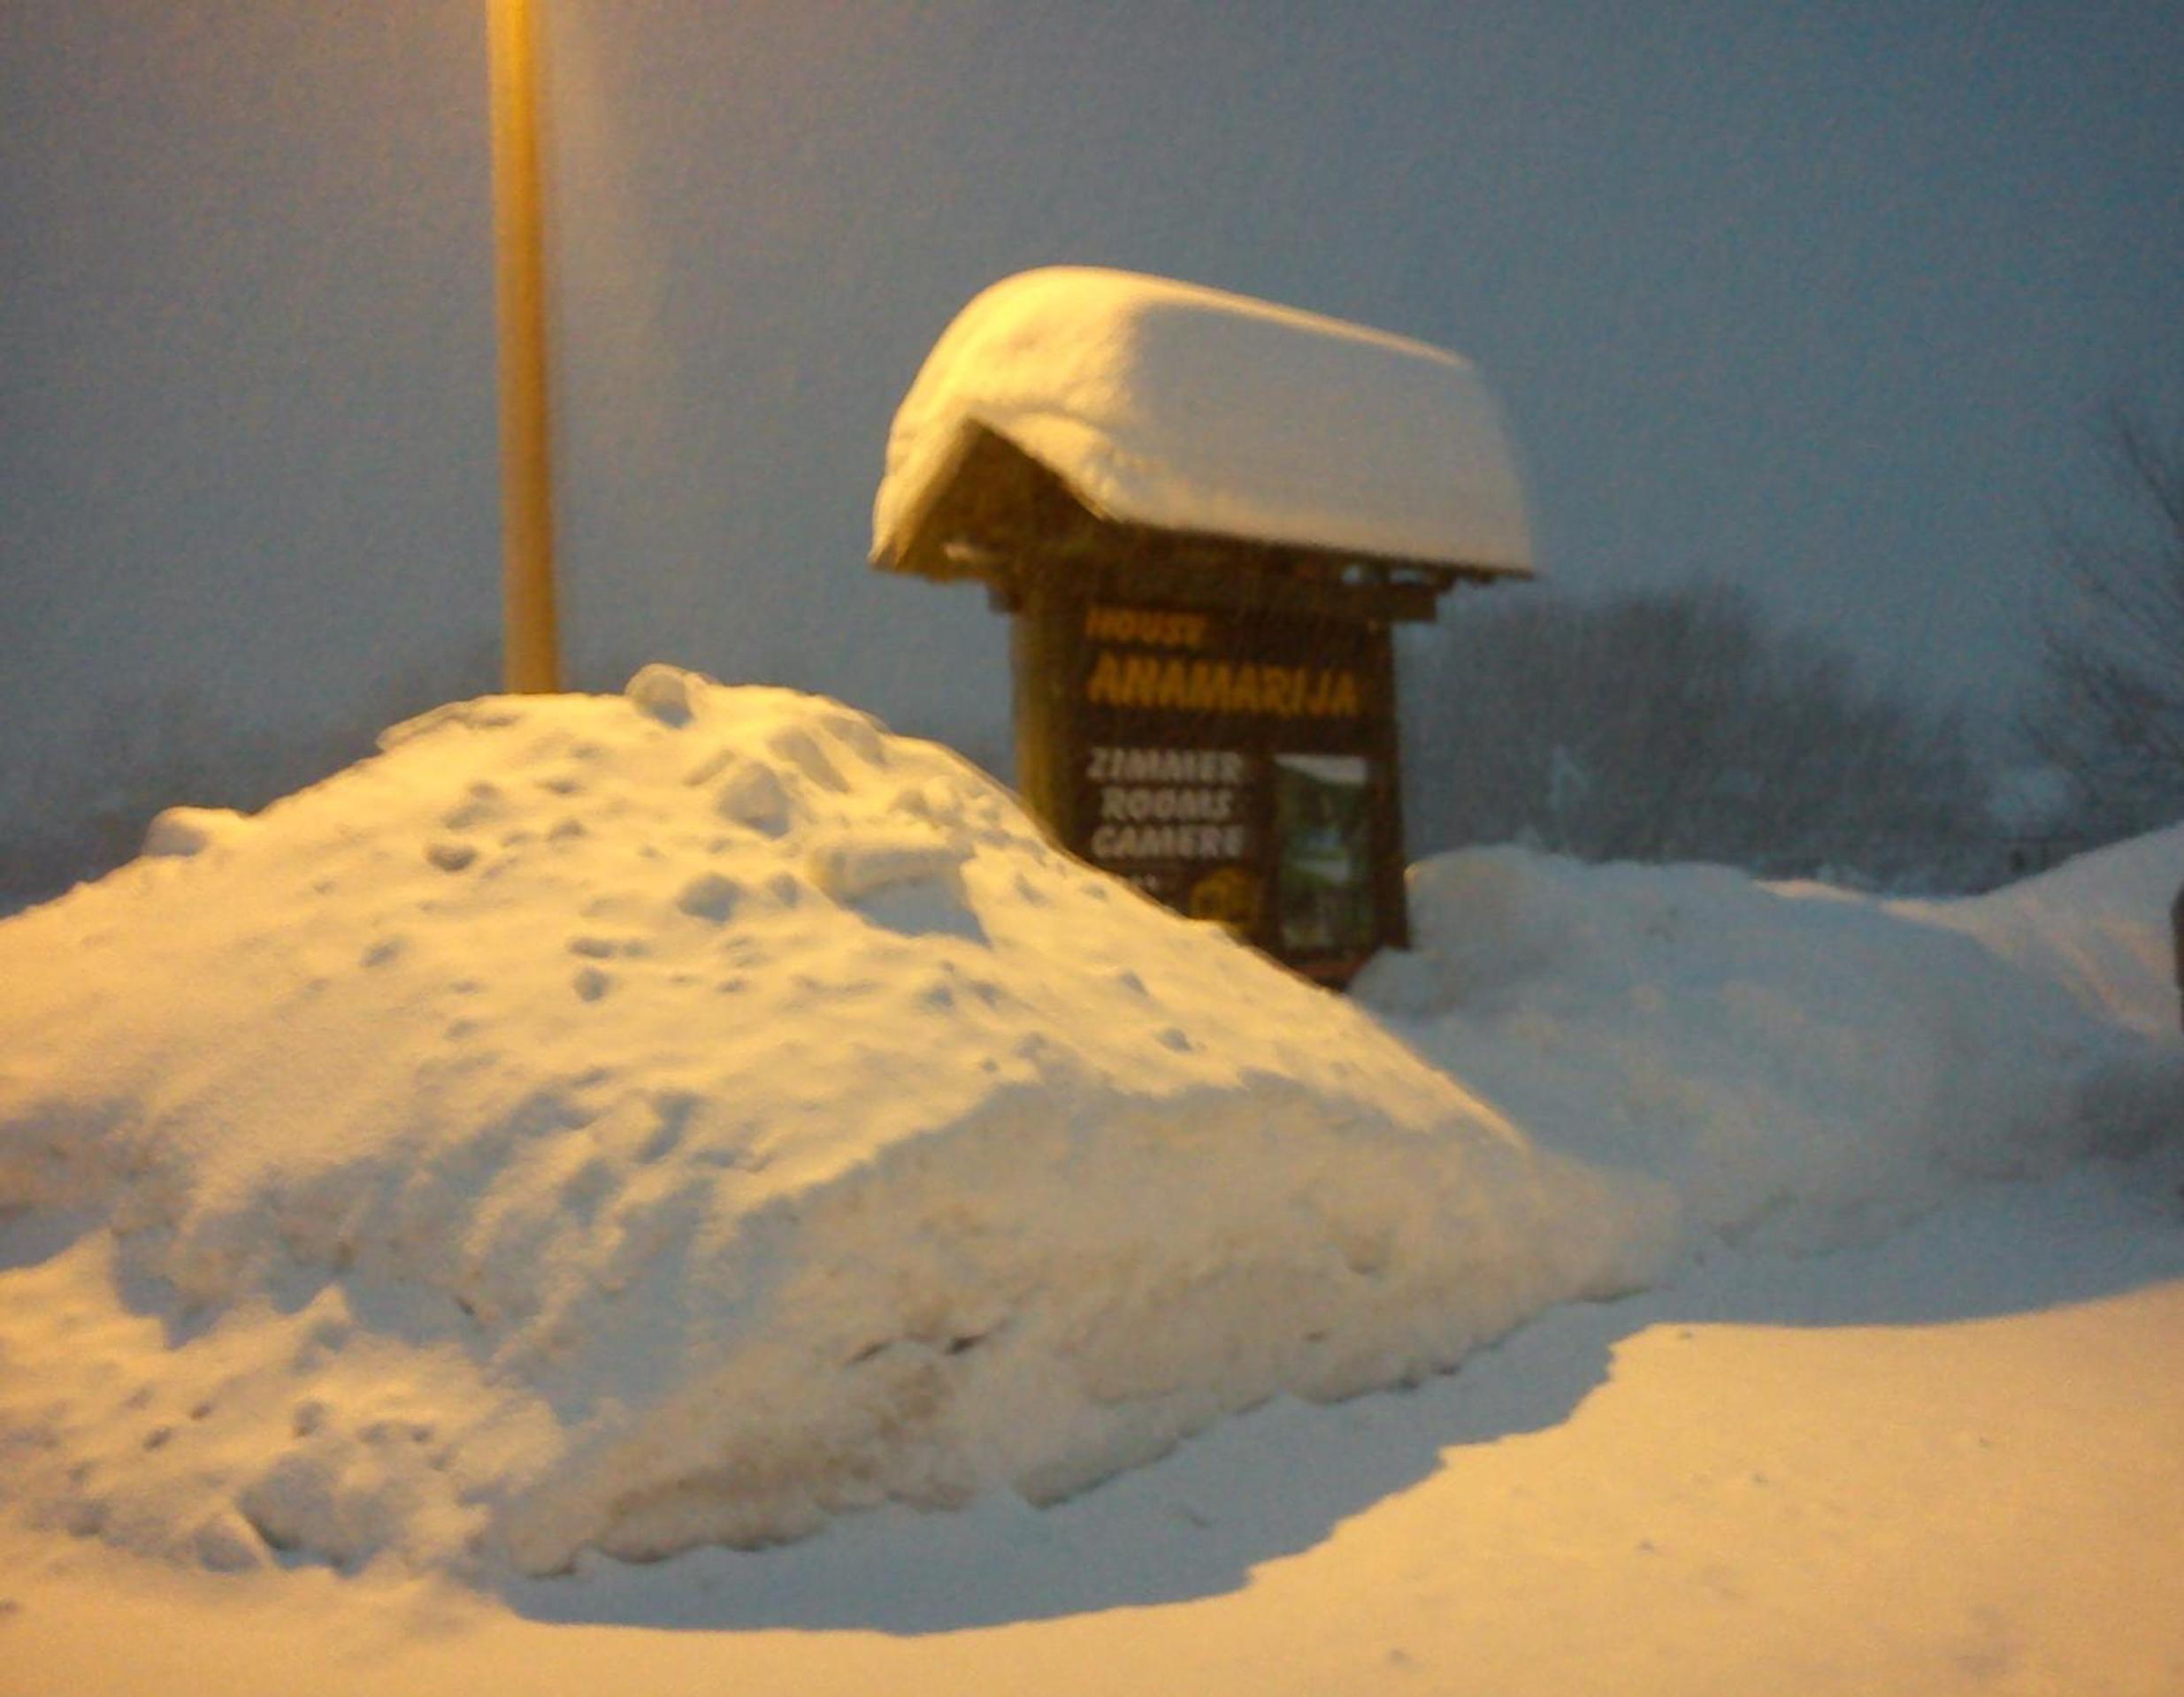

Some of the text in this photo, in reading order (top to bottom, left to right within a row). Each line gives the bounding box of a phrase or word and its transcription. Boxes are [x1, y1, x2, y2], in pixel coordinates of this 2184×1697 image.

[1087, 653, 1359, 716] ANAMARIJA
[1086, 746, 1245, 784] ZIMMER
[1100, 786, 1234, 822] ROOMS
[1090, 824, 1244, 859] CAMERE
